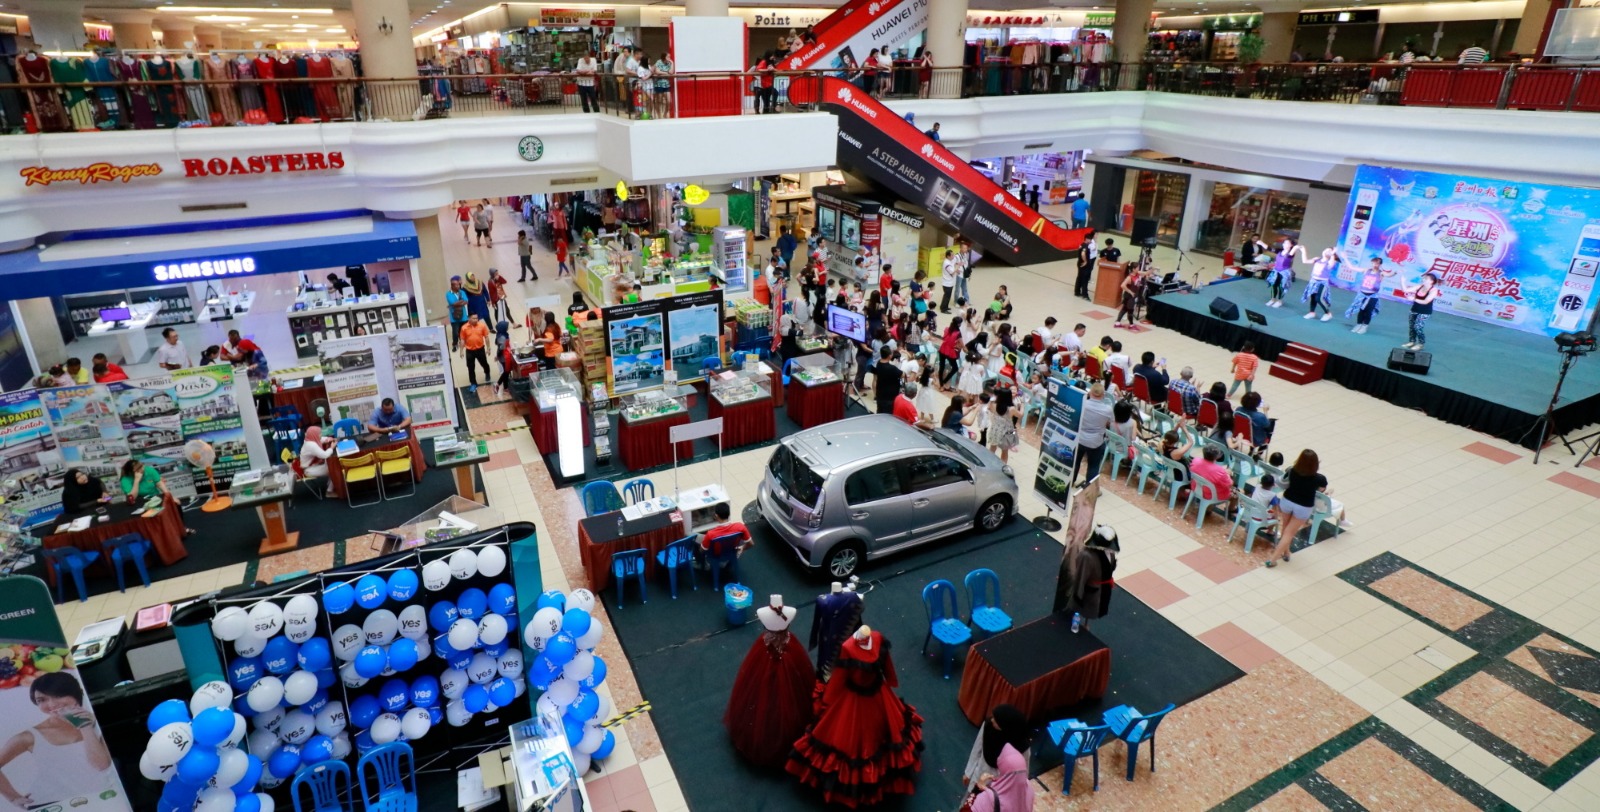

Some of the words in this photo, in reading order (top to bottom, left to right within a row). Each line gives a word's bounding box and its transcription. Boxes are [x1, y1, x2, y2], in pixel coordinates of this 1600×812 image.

[754, 13, 790, 26] Point
[871, 7, 911, 40] HUAWEI
[983, 16, 1044, 25] SAKURA
[802, 42, 826, 62] HUAWEI
[851, 98, 877, 119] HUAWEI
[838, 130, 863, 149] HUAWEI
[20, 165, 89, 186] Kenny
[88, 162, 163, 184] Rogers
[182, 151, 345, 177] ROASTERS
[872, 147, 879, 157] A
[880, 151, 899, 168] STEP
[898, 164, 926, 186] AHEAD
[933, 153, 956, 172] HUAWEI
[1003, 200, 1023, 217] HUAWEI
[974, 213, 1000, 233] HUAWEI
[999, 229, 1013, 242] Mate
[1012, 238, 1018, 246] 9
[1447, 217, 1492, 241] 星洲
[153, 256, 256, 281] SAMSUNG
[8, 408, 43, 424] PANTAI
[13, 420, 45, 432] Contoh
[361, 589, 379, 601] yes
[392, 590, 409, 598] yes
[0, 607, 35, 620] GREEN
[255, 619, 276, 631] yes
[289, 617, 307, 625] yes
[401, 620, 421, 629] yes
[290, 630, 307, 640] yes
[339, 633, 358, 648] yes
[365, 631, 383, 640] yes
[239, 647, 255, 656] yes
[362, 647, 380, 656] yes
[267, 658, 286, 669] yes
[454, 658, 470, 669] yes
[502, 660, 519, 669] yes
[235, 664, 255, 679] yes
[475, 668, 492, 680] yes
[204, 682, 225, 694] yes
[414, 690, 432, 699] yes
[309, 698, 327, 712] yes
[387, 693, 405, 706] yes
[264, 715, 281, 731] yes
[330, 712, 345, 724] ye
[285, 727, 305, 742] yes
[167, 731, 189, 752] yes
